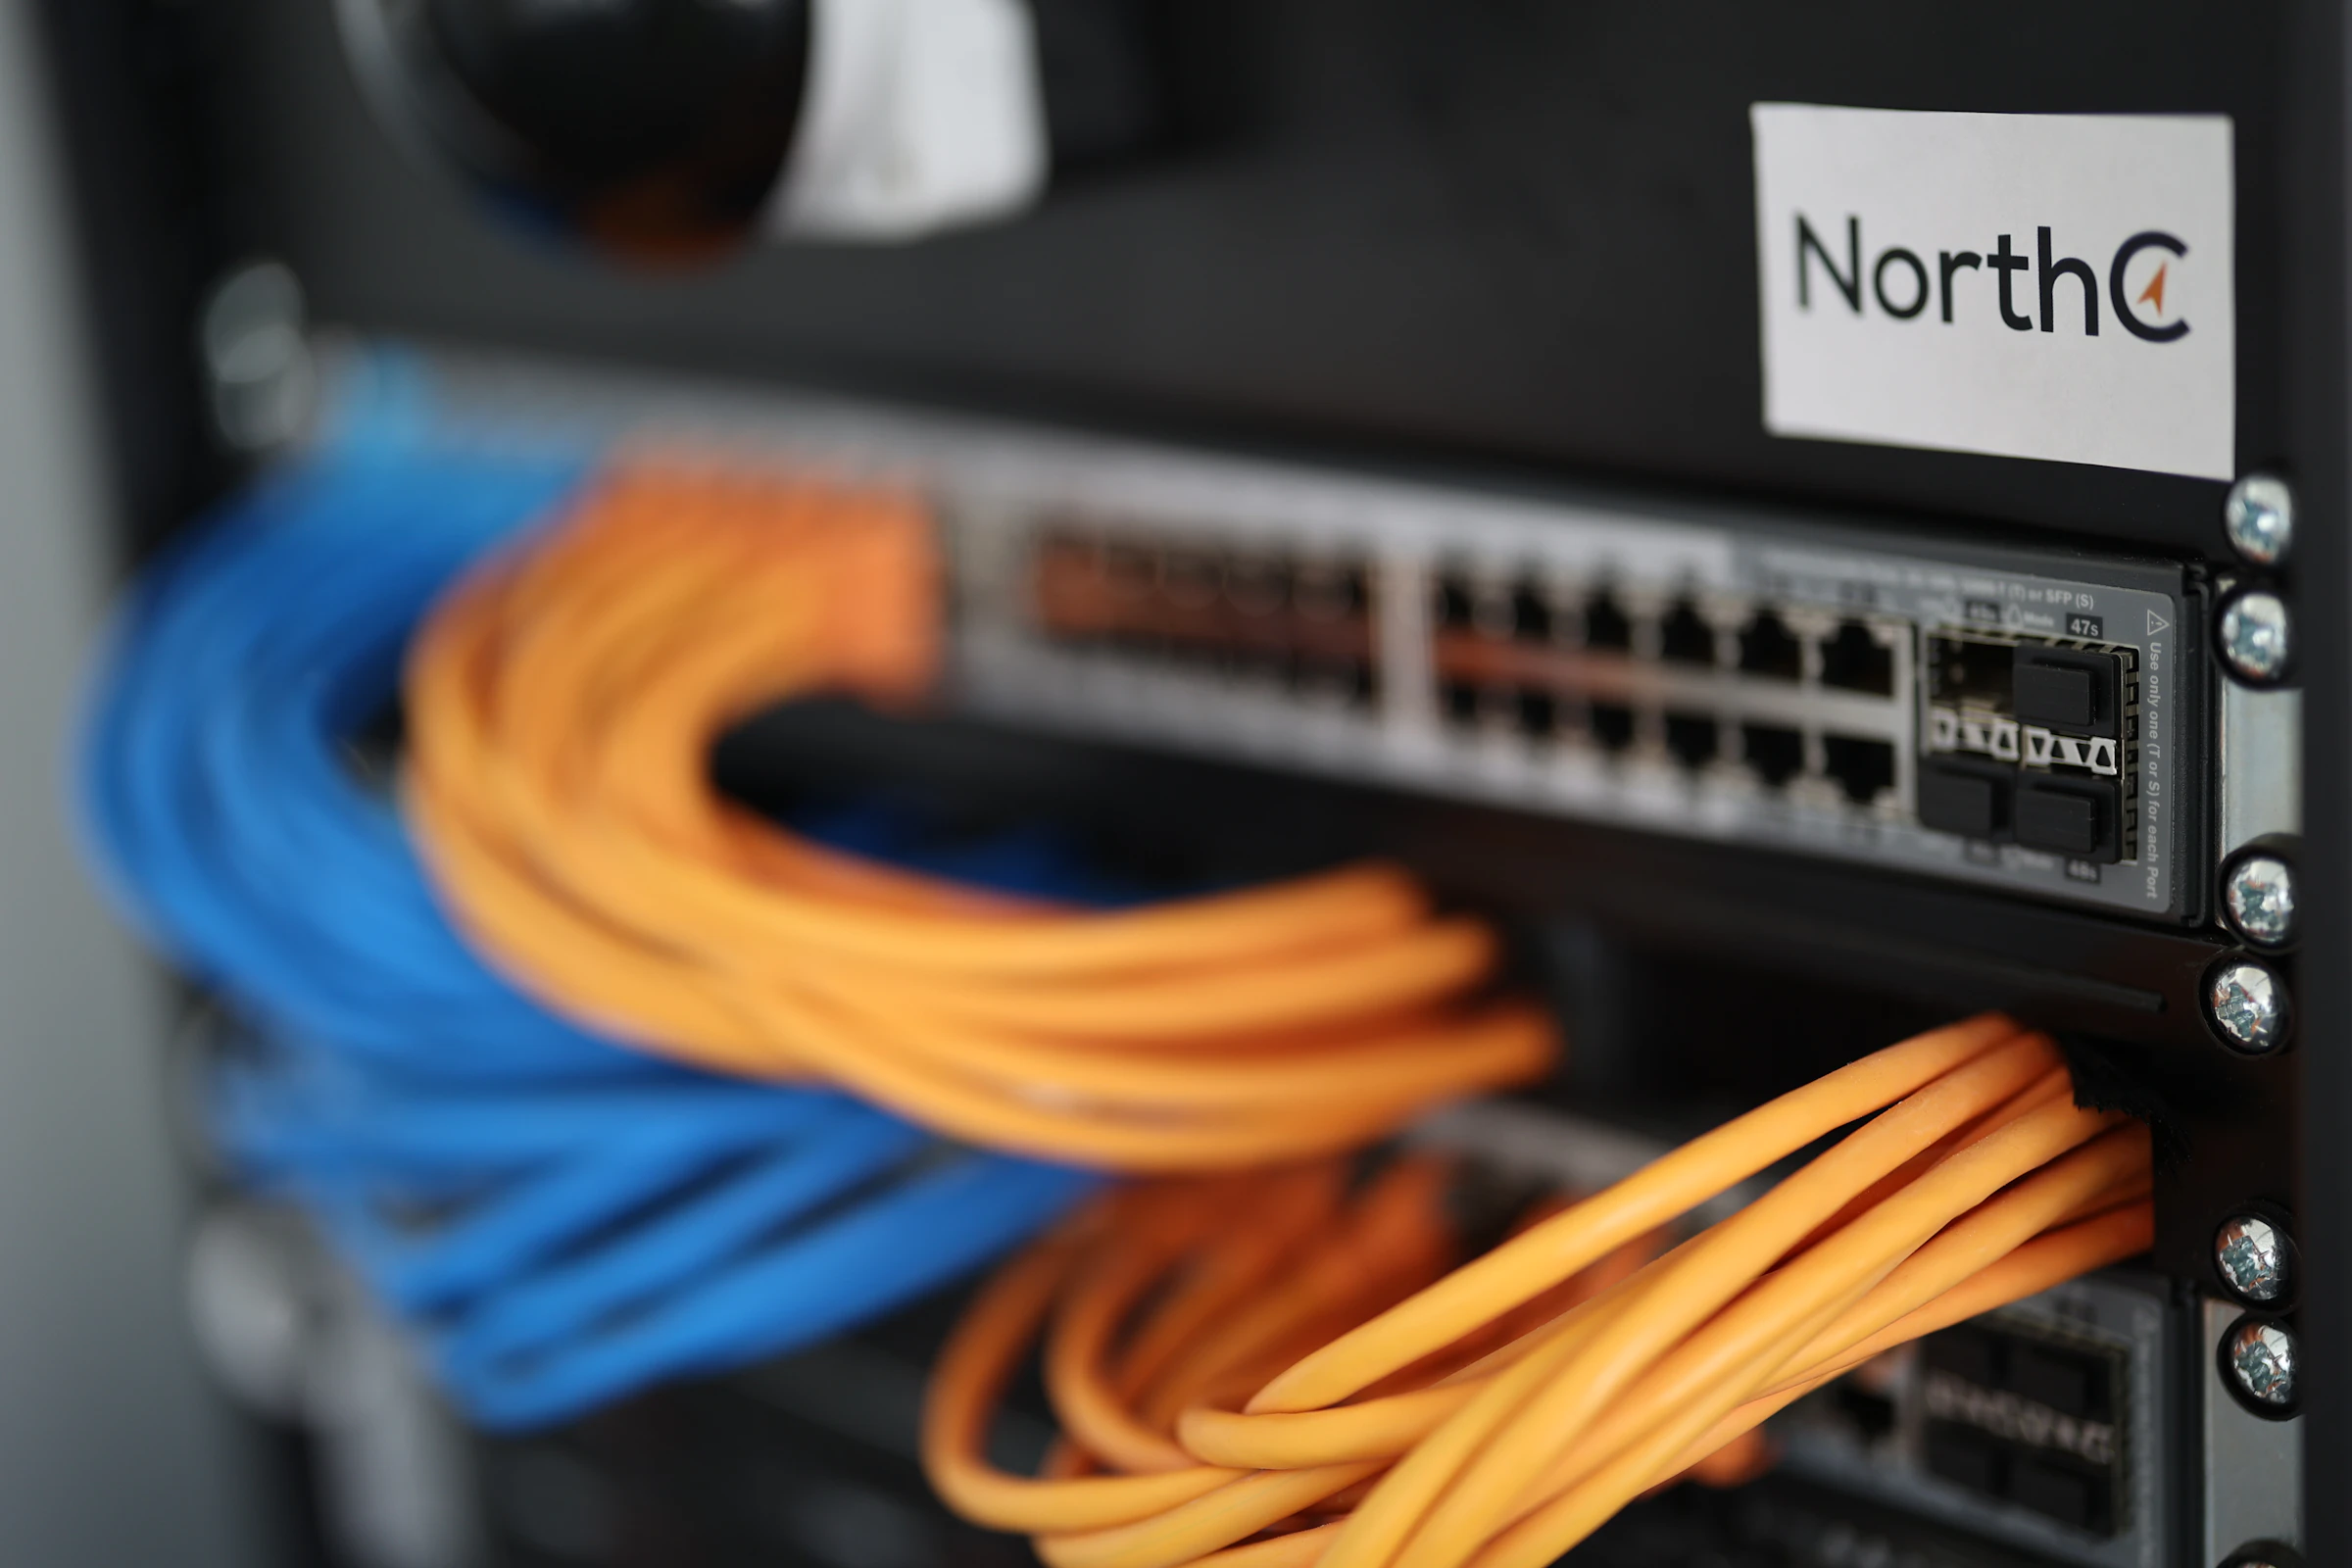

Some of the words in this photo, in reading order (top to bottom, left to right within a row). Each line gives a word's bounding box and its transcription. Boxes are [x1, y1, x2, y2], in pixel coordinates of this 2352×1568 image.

[1792, 211, 2191, 343] NorthC
[2045, 589, 2073, 606] SFP
[2076, 593, 2094, 611] (S)
[2070, 618, 2099, 637] 47s
[2149, 641, 2162, 671] Use
[2146, 674, 2162, 708] only
[2149, 710, 2159, 740] one
[2146, 743, 2161, 759] (T
[2148, 761, 2158, 777] or
[2145, 780, 2160, 797] S)
[2147, 800, 2160, 822] for
[2147, 824, 2159, 862] each
[2145, 865, 2159, 899] Port
